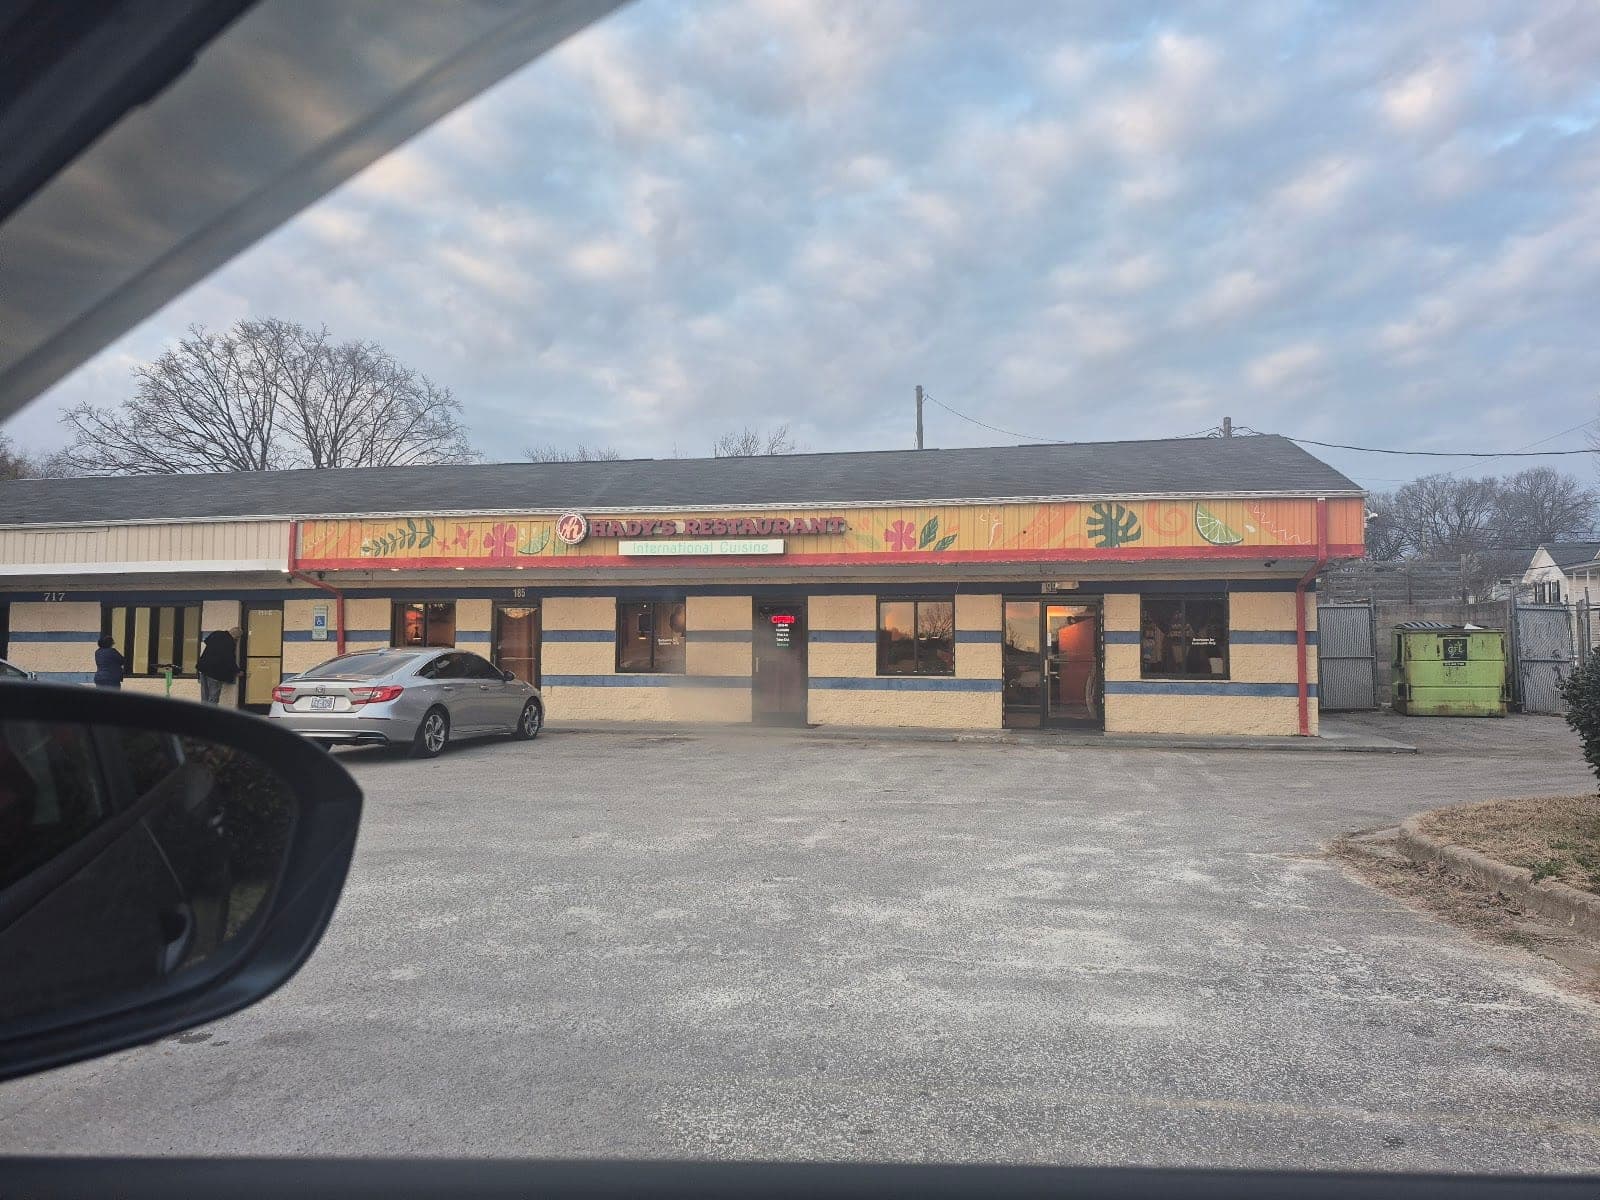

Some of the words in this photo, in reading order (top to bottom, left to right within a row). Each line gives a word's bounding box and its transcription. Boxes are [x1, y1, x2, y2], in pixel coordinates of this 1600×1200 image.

[590, 519, 676, 537] HADY'S
[683, 517, 845, 536] RESTAURANT
[633, 541, 713, 554] International
[719, 541, 769, 553] Cuisine
[43, 592, 65, 601] 717
[771, 615, 795, 624] OPEN
